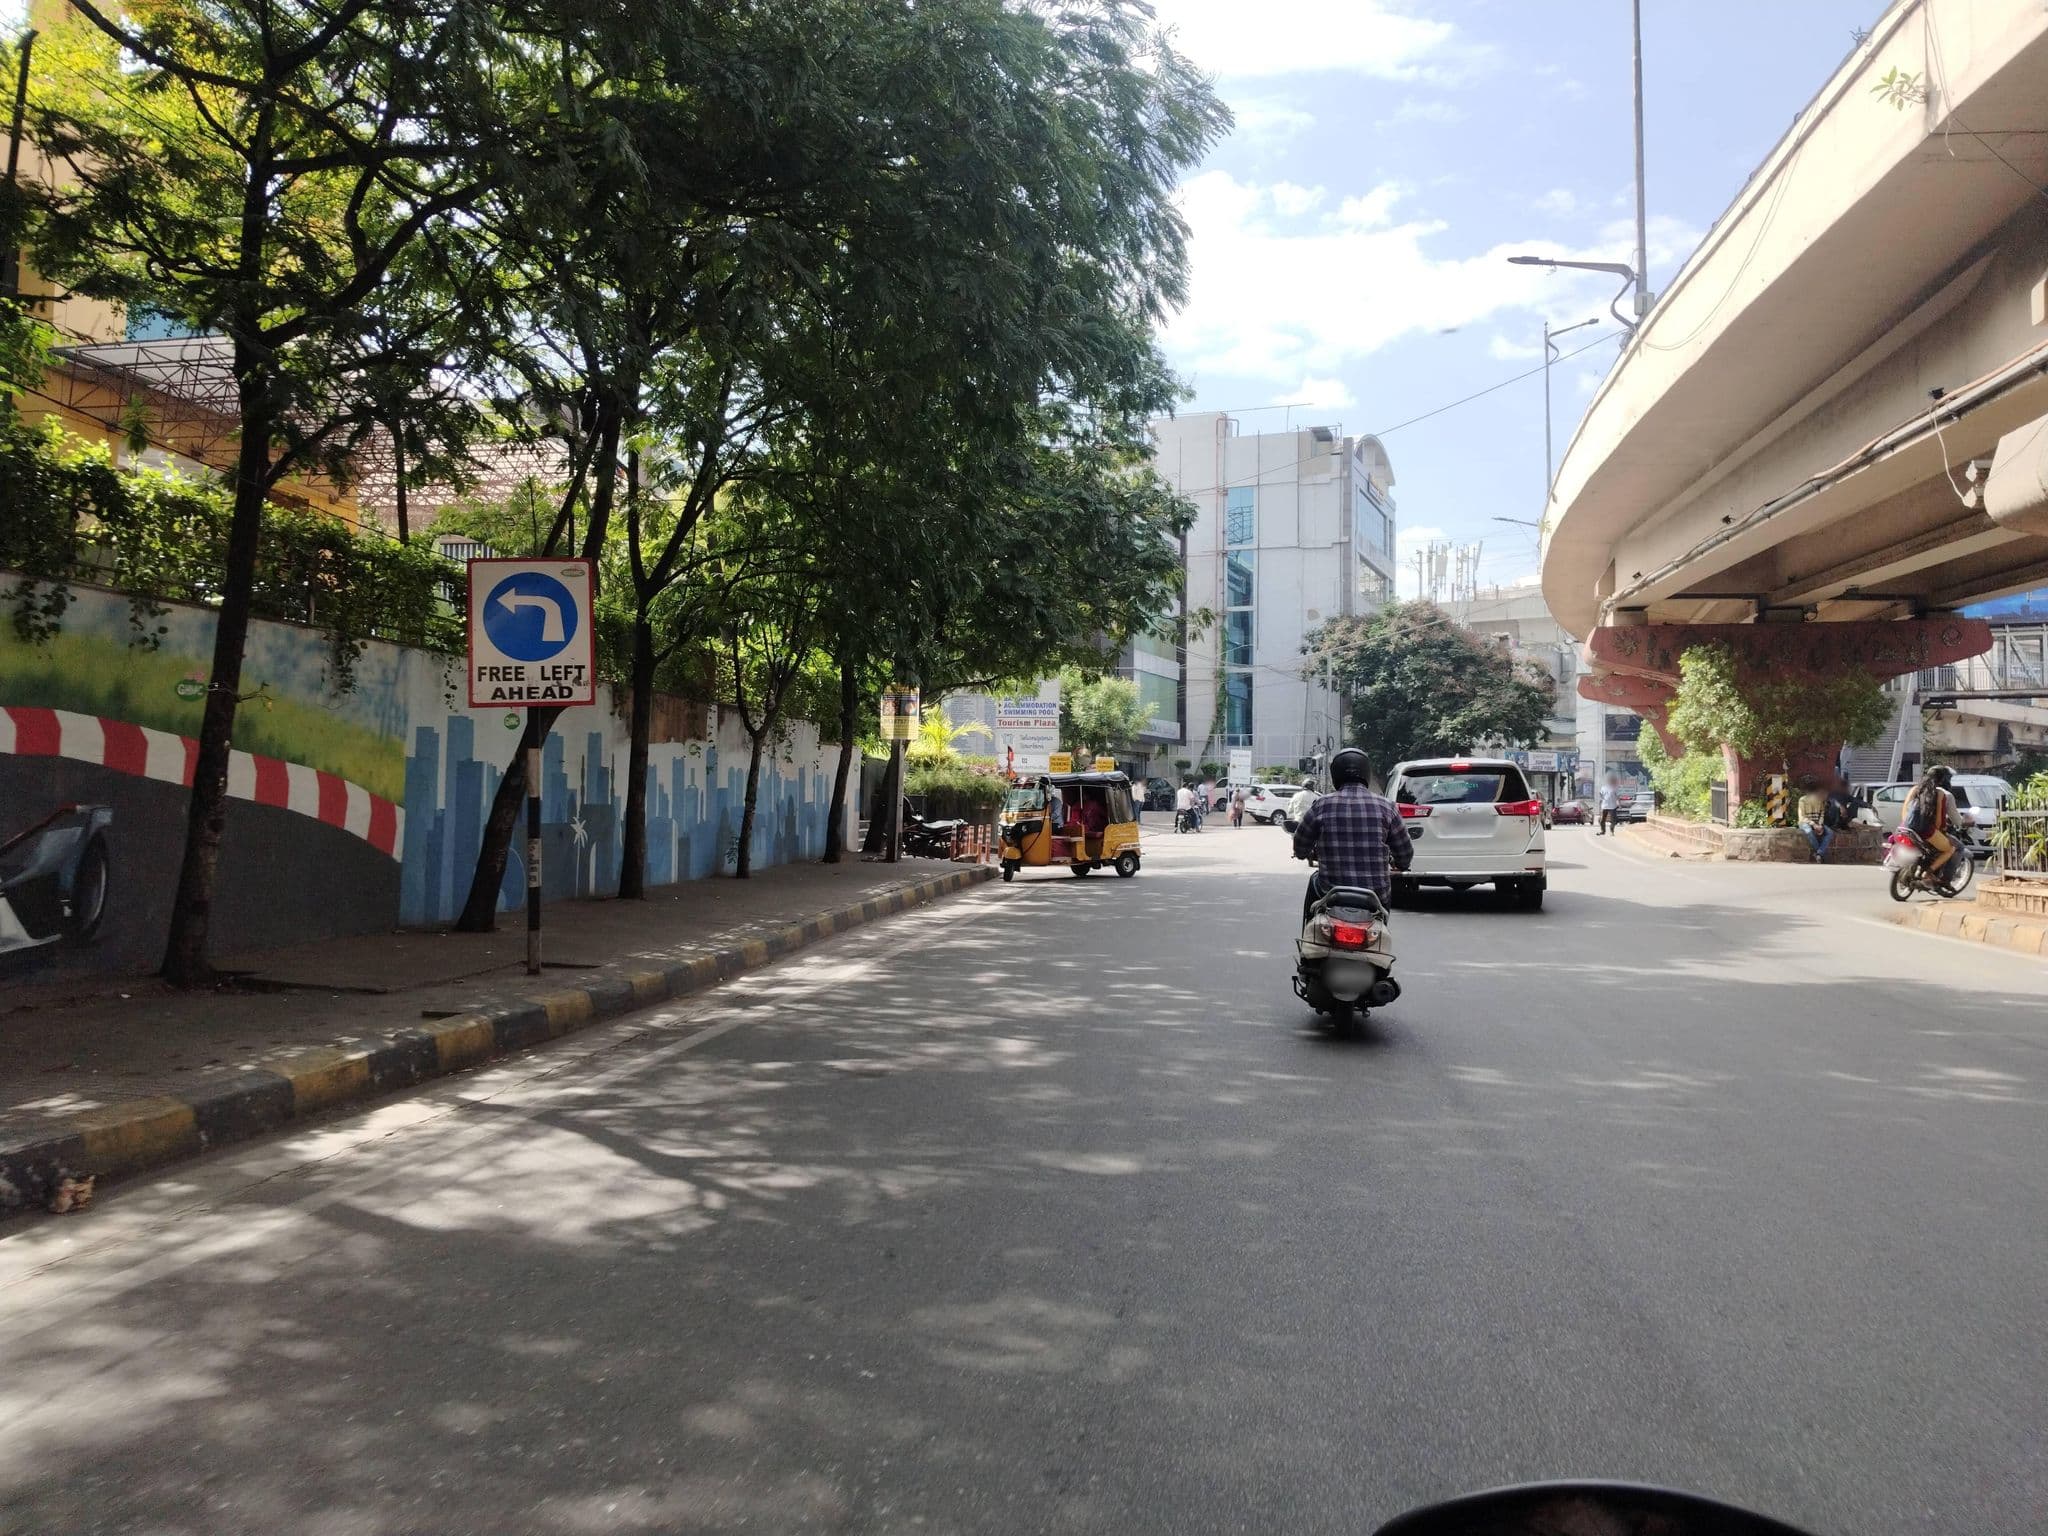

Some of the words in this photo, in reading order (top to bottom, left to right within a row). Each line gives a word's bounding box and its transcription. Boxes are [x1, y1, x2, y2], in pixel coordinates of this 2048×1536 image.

[477, 666, 525, 682] FREE
[540, 665, 586, 681] LEFT
[491, 686, 574, 700] AHEAD
[998, 719, 1031, 727] Tourism
[1034, 719, 1057, 727] Plaza
